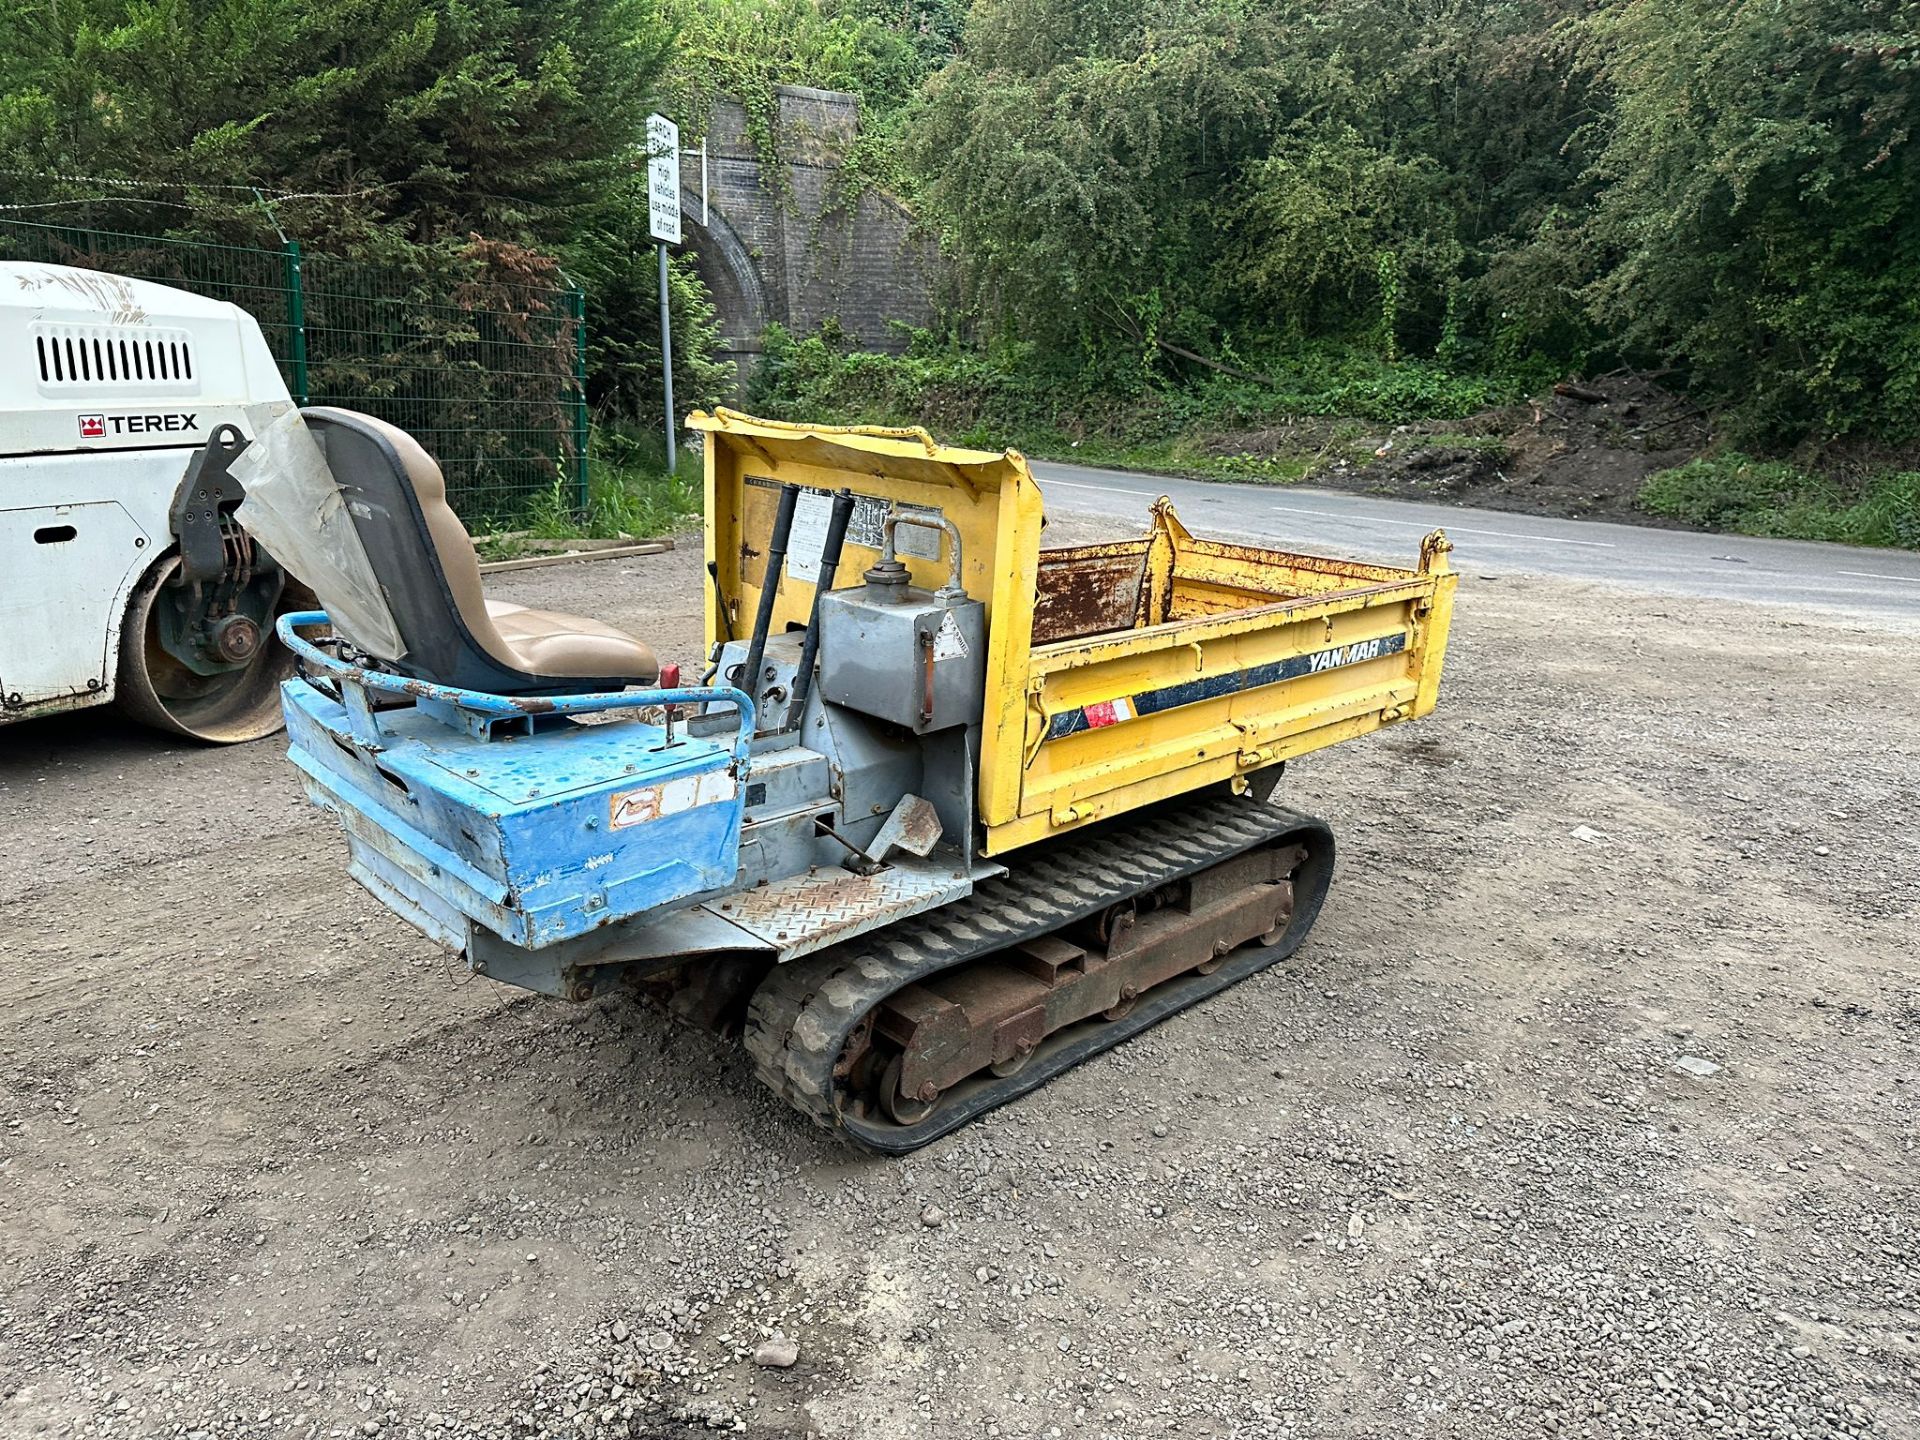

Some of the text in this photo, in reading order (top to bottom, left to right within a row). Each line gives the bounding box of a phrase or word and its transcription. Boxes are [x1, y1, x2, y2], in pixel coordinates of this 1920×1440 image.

[653, 120, 671, 141] ARCH
[658, 163, 670, 181] High
[654, 182, 675, 200] vehicles
[652, 200, 679, 219] use middle
[657, 217, 675, 235] of road
[108, 413, 199, 433] TEREX
[1309, 639, 1380, 672] YANMAR
